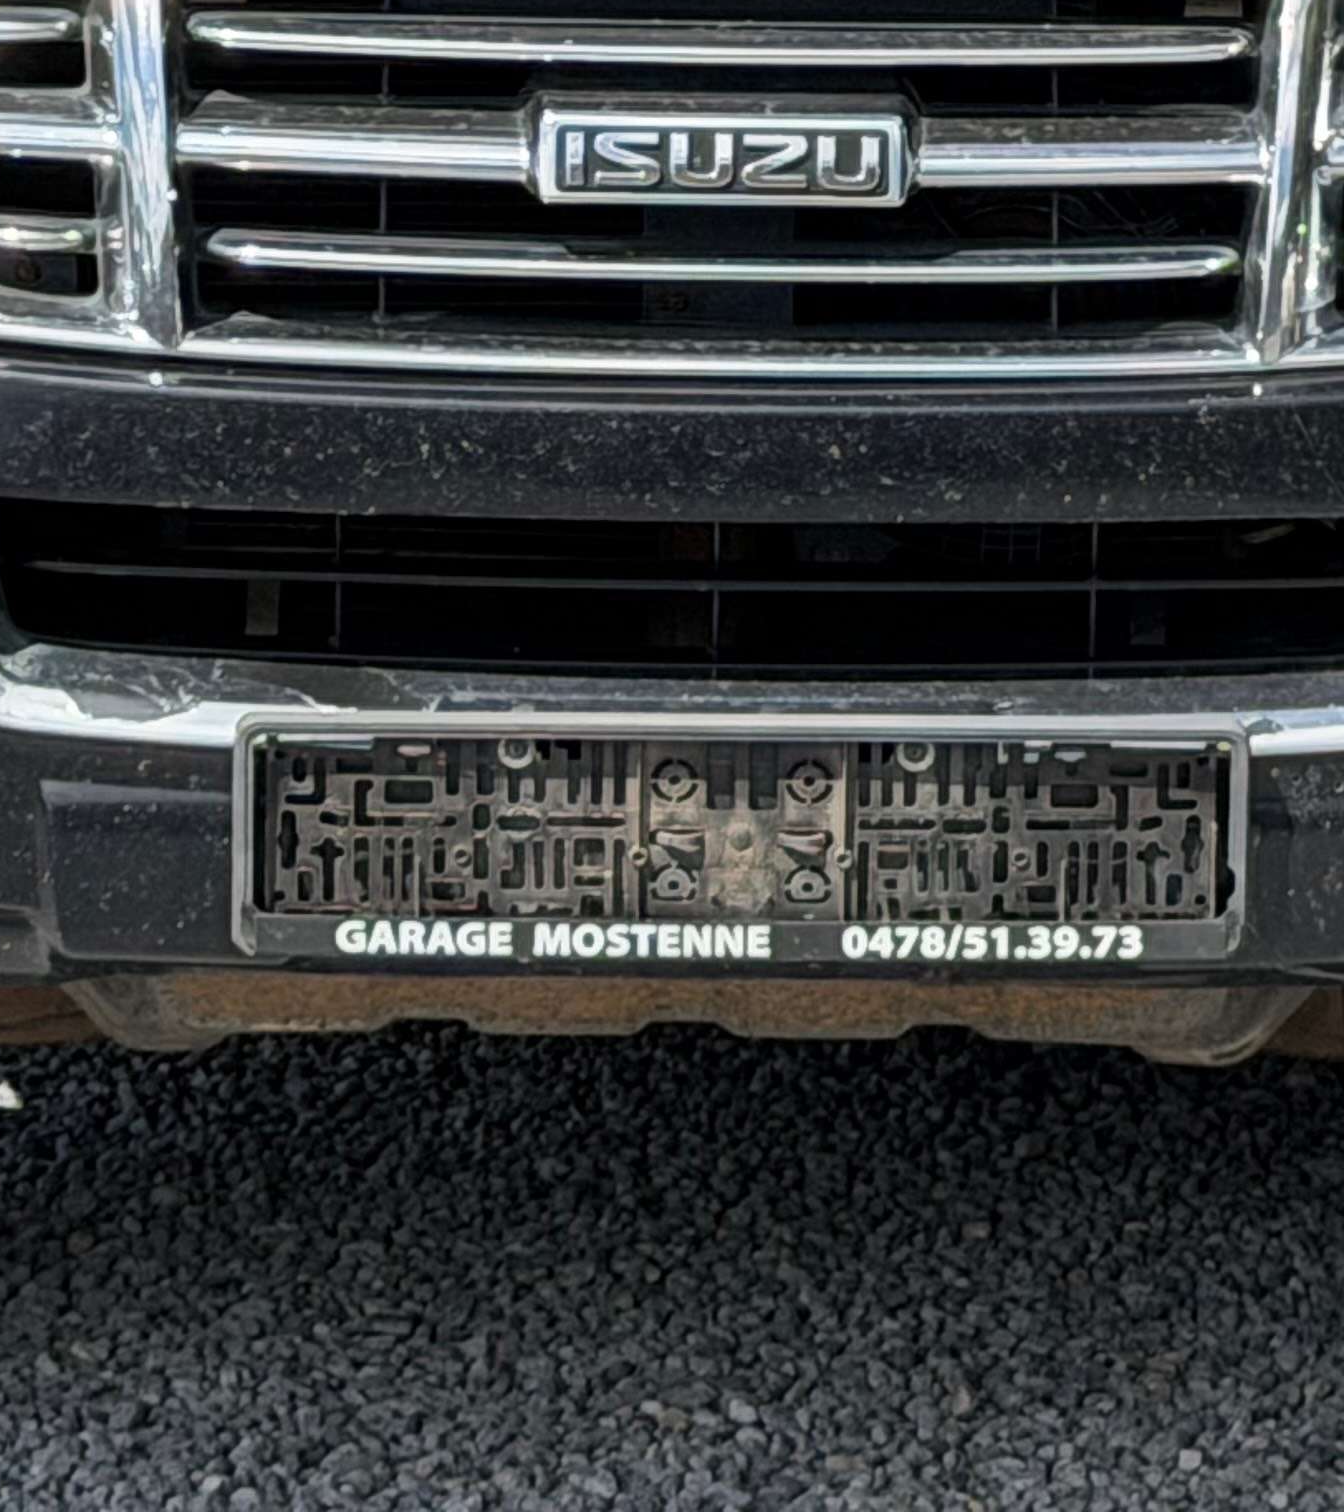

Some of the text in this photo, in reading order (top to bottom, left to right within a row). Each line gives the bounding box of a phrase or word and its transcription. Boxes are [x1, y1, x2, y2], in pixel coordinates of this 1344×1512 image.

[564, 130, 881, 191] ISUZU
[334, 919, 1144, 960] GARAGE MOSTENNE 0478/51.39.73
